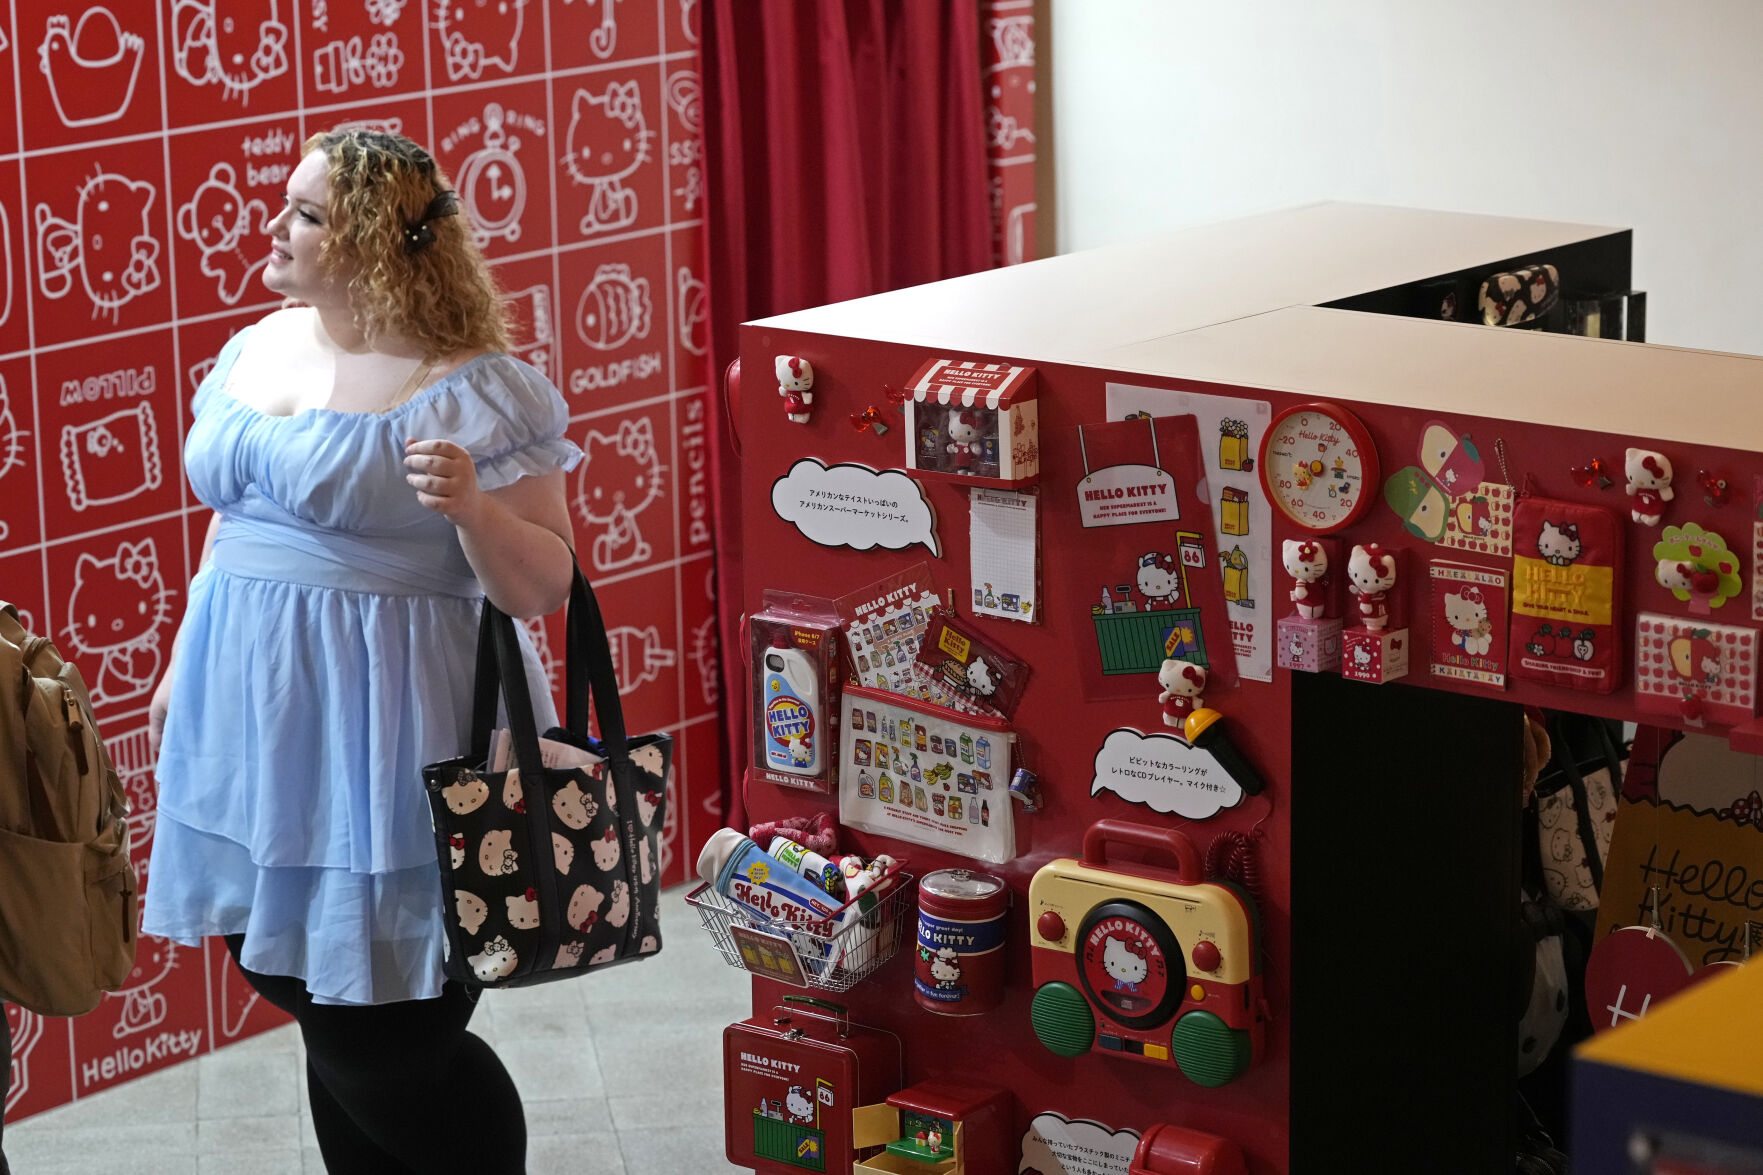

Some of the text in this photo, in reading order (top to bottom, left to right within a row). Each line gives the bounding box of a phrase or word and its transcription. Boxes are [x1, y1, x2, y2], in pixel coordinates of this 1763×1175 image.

[441, 109, 546, 153] RING RING
[241, 128, 295, 159] teddy
[246, 163, 291, 187] bear
[569, 352, 662, 395] GOLDFISH
[943, 369, 972, 377] HELLO
[59, 365, 156, 406] PILLOW
[1301, 418, 1308, 427] 0
[1329, 421, 1342, 431] 20
[1345, 448, 1360, 458] 40
[682, 399, 711, 545] pencils
[809, 489, 898, 508] アメリカンなテイストいっぱいの
[1084, 483, 1167, 502] HELLO KITTY
[799, 500, 909, 523] アメリカンスーパーマーケットシリーズ。
[1291, 498, 1304, 507] 60
[1340, 498, 1353, 508] 20
[1312, 510, 1326, 520] 40
[1184, 550, 1200, 563] 86
[1526, 565, 1584, 584] HELLO
[854, 582, 917, 617] HELLO KITTY
[1229, 620, 1254, 633] ELLO
[1232, 631, 1253, 642] TTY
[1289, 662, 1305, 670] 1997
[768, 705, 808, 723] HELLO
[772, 719, 810, 738] KITTY
[765, 772, 815, 788] HELLO KITTY
[734, 882, 780, 918] Hello
[933, 932, 975, 946] KITTY
[1090, 920, 1161, 956] HELLO KITTY
[740, 1051, 801, 1073] HELLO KITTY
[819, 1091, 830, 1102] 86
